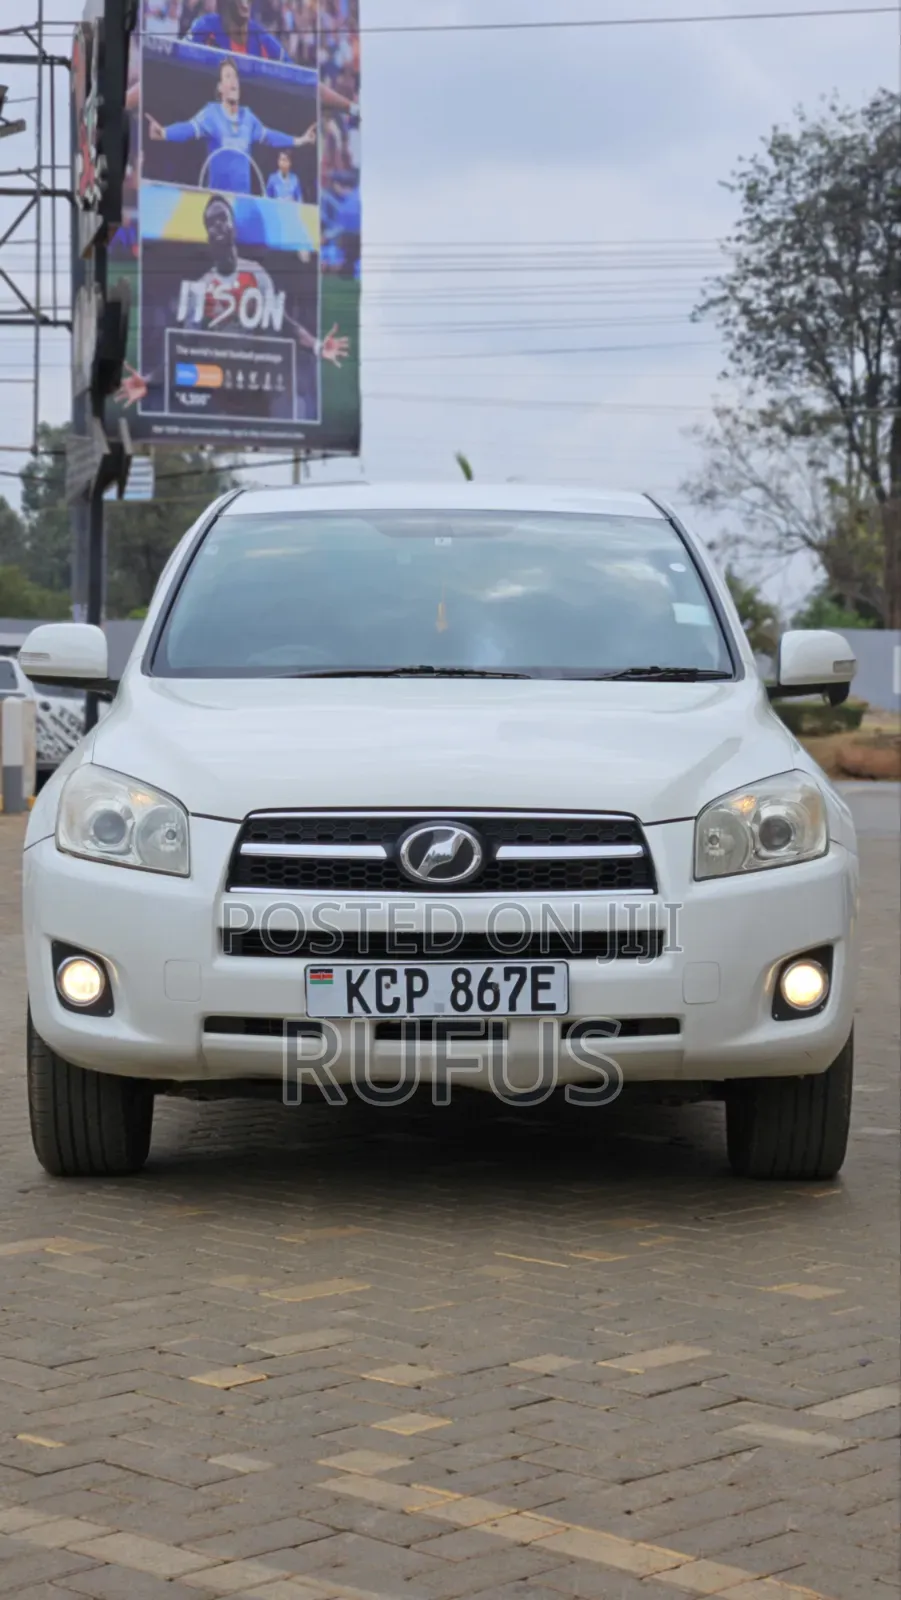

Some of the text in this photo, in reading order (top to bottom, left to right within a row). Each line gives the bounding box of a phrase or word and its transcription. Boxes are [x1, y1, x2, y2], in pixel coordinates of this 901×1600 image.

[239, 287, 286, 332] ON
[346, 965, 557, 1014] KCP 867E
